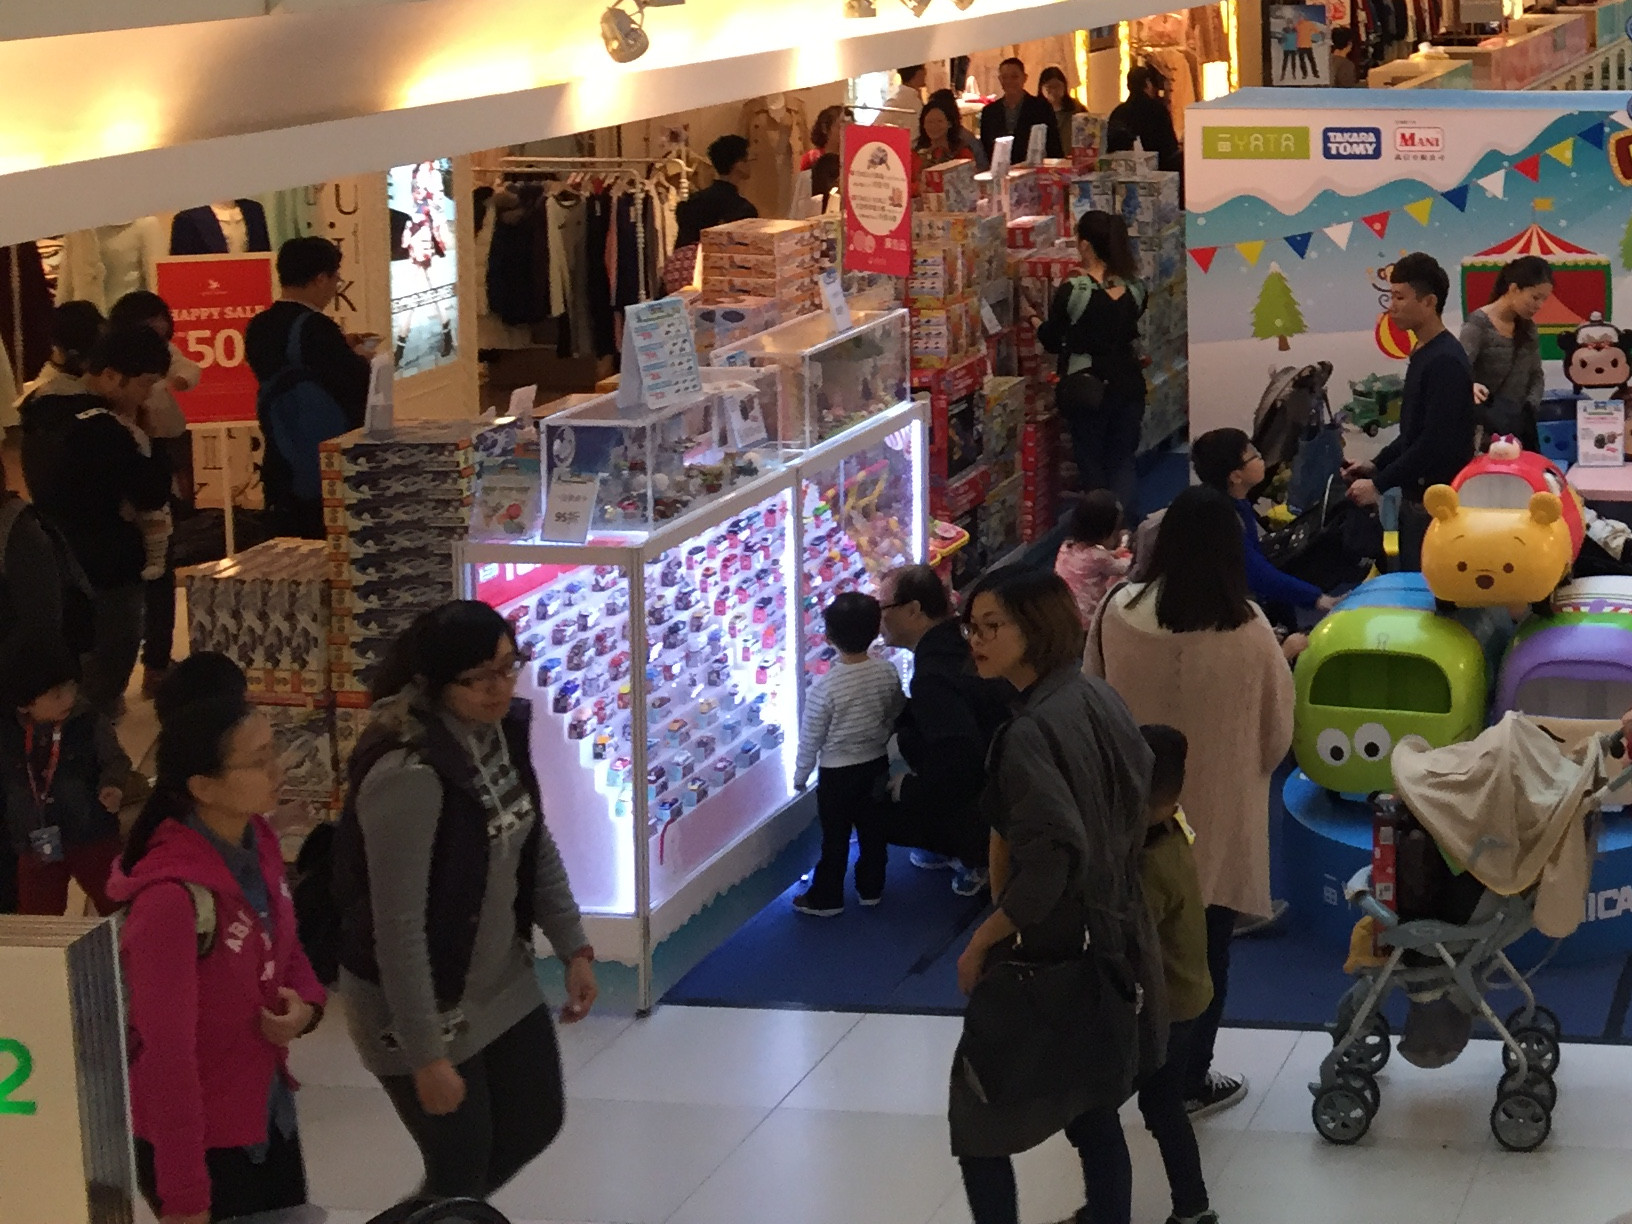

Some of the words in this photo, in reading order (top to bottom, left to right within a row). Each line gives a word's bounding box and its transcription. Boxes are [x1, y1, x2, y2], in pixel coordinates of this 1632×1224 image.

[1234, 134, 1295, 152] YATA
[1327, 132, 1376, 142] TAKARA
[1328, 143, 1377, 155] TOMY
[171, 307, 221, 322] HAPPY
